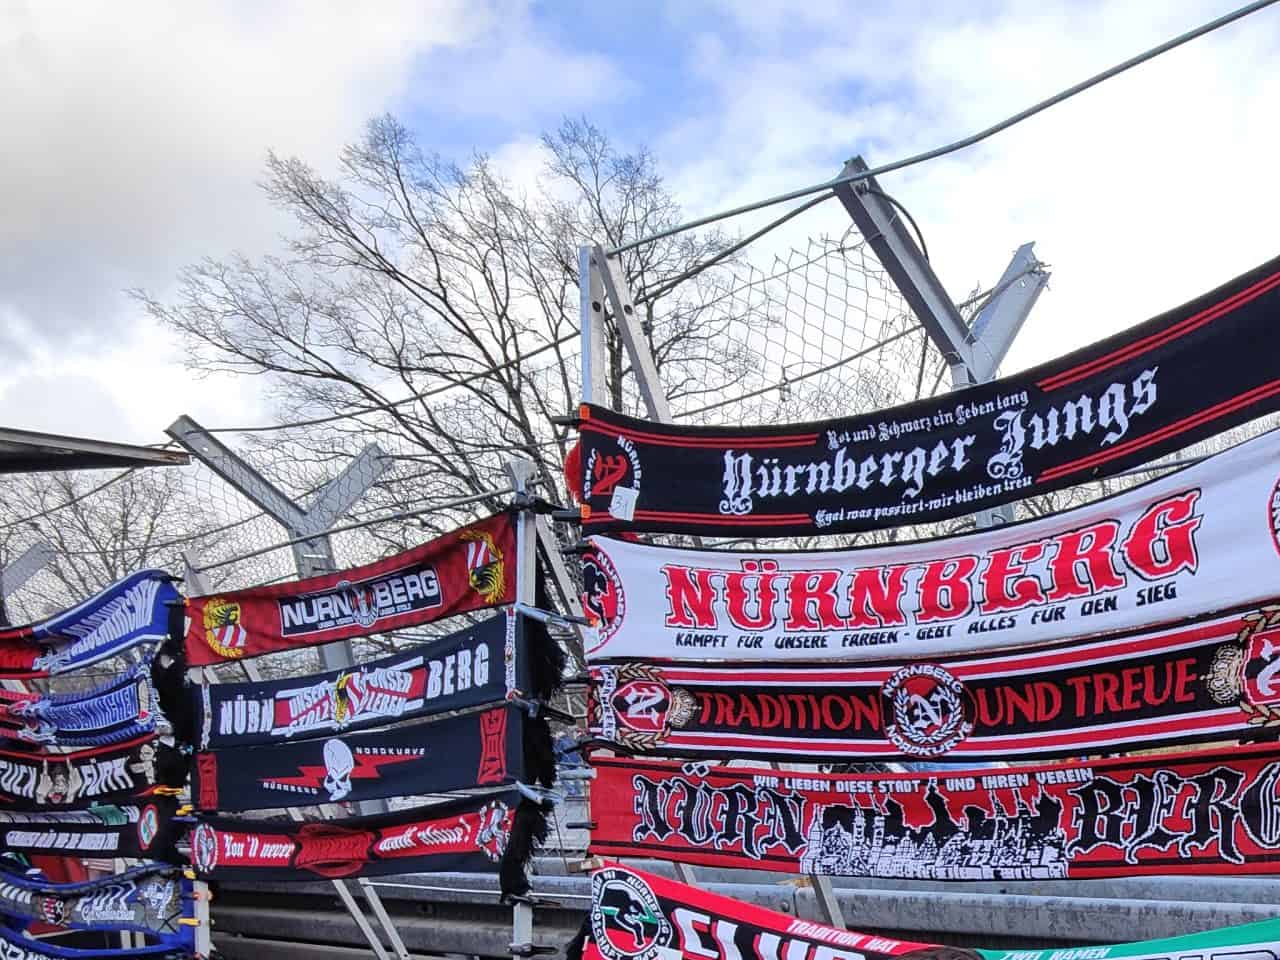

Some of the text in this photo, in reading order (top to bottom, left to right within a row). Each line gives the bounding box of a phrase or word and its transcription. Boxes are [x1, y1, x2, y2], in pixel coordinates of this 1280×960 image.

[719, 366, 1160, 515] Nürnberger Jungs
[373, 569, 439, 606] BERG
[660, 490, 1203, 632] NÜRNBERG
[737, 630, 763, 648] FÜR
[774, 634, 829, 649] UNSERE
[841, 630, 898, 647] FARBEN
[916, 624, 953, 640] GEBT
[967, 615, 1016, 635] ALLES
[1031, 603, 1066, 625] FÜR
[1081, 598, 1118, 617] DEN
[1135, 582, 1177, 607] SIEG
[427, 643, 489, 699] BERG
[700, 657, 1197, 731] TRADITION UND TREUE
[355, 747, 425, 756] NORDKURVE
[753, 768, 1094, 793] WIR LIEBEN DIESE STADT UND IHREN VEREIN
[787, 919, 903, 953] TRADITION HAT
